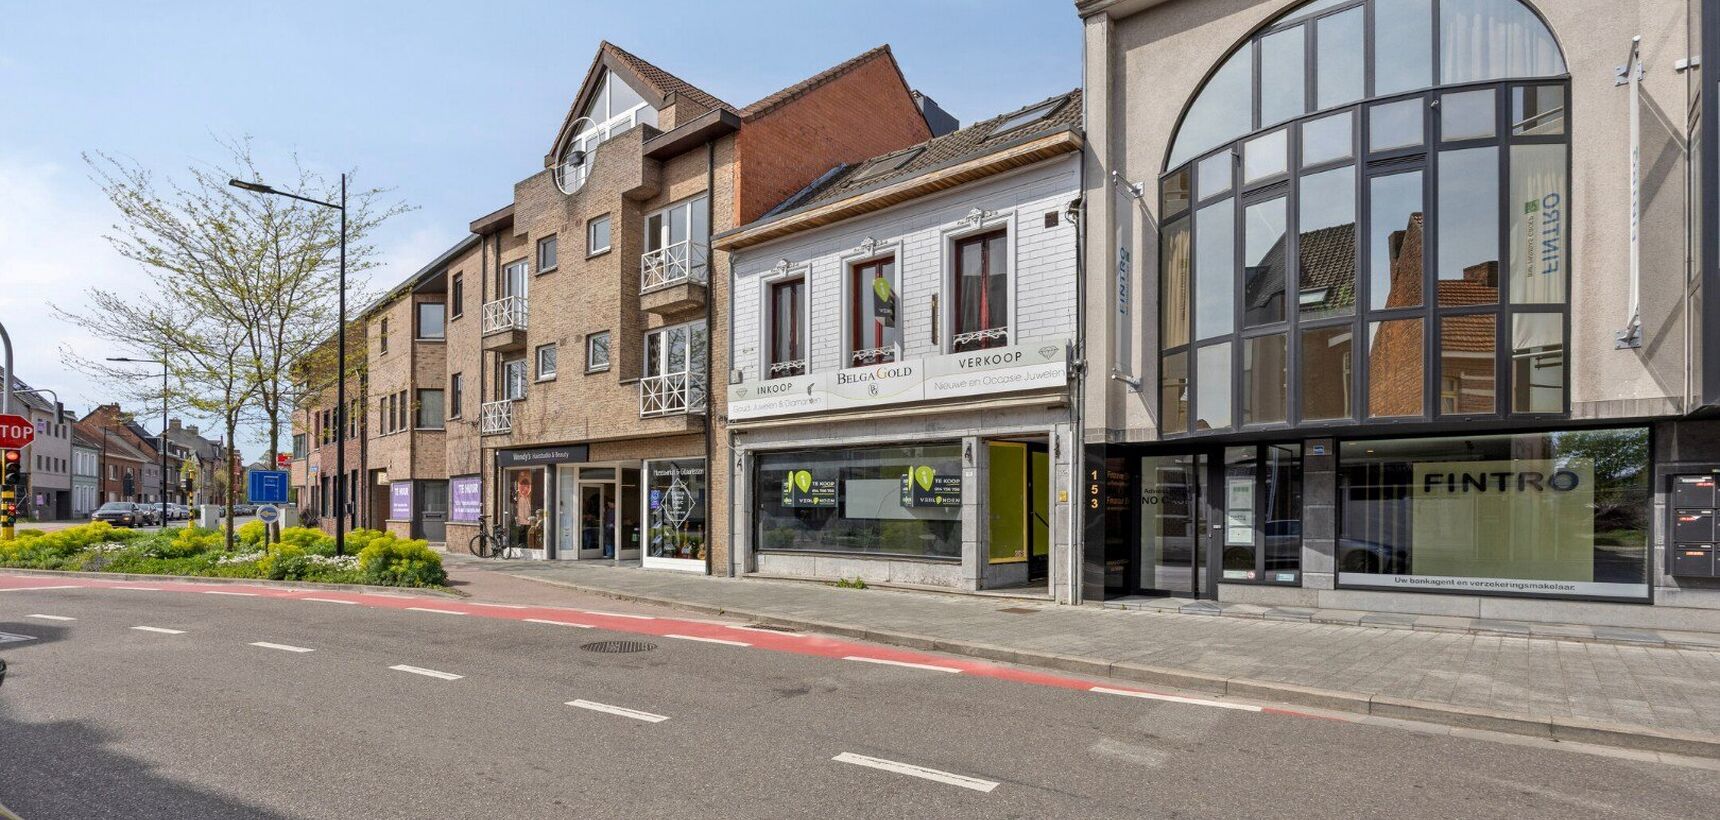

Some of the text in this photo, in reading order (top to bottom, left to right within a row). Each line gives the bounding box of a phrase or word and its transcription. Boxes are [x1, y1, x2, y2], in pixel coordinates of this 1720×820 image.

[959, 351, 1022, 368] VERKOOP
[934, 369, 1066, 390] Nieuwe en Occasie Juwelen
[757, 382, 792, 394] INKOOP
[0, 425, 33, 439] TOP
[1424, 471, 1579, 492] FINTRO
[1142, 496, 1158, 505] NO
[1409, 577, 1454, 587] bankagent
[1470, 580, 1576, 591] verzekeringsmakelaar.
